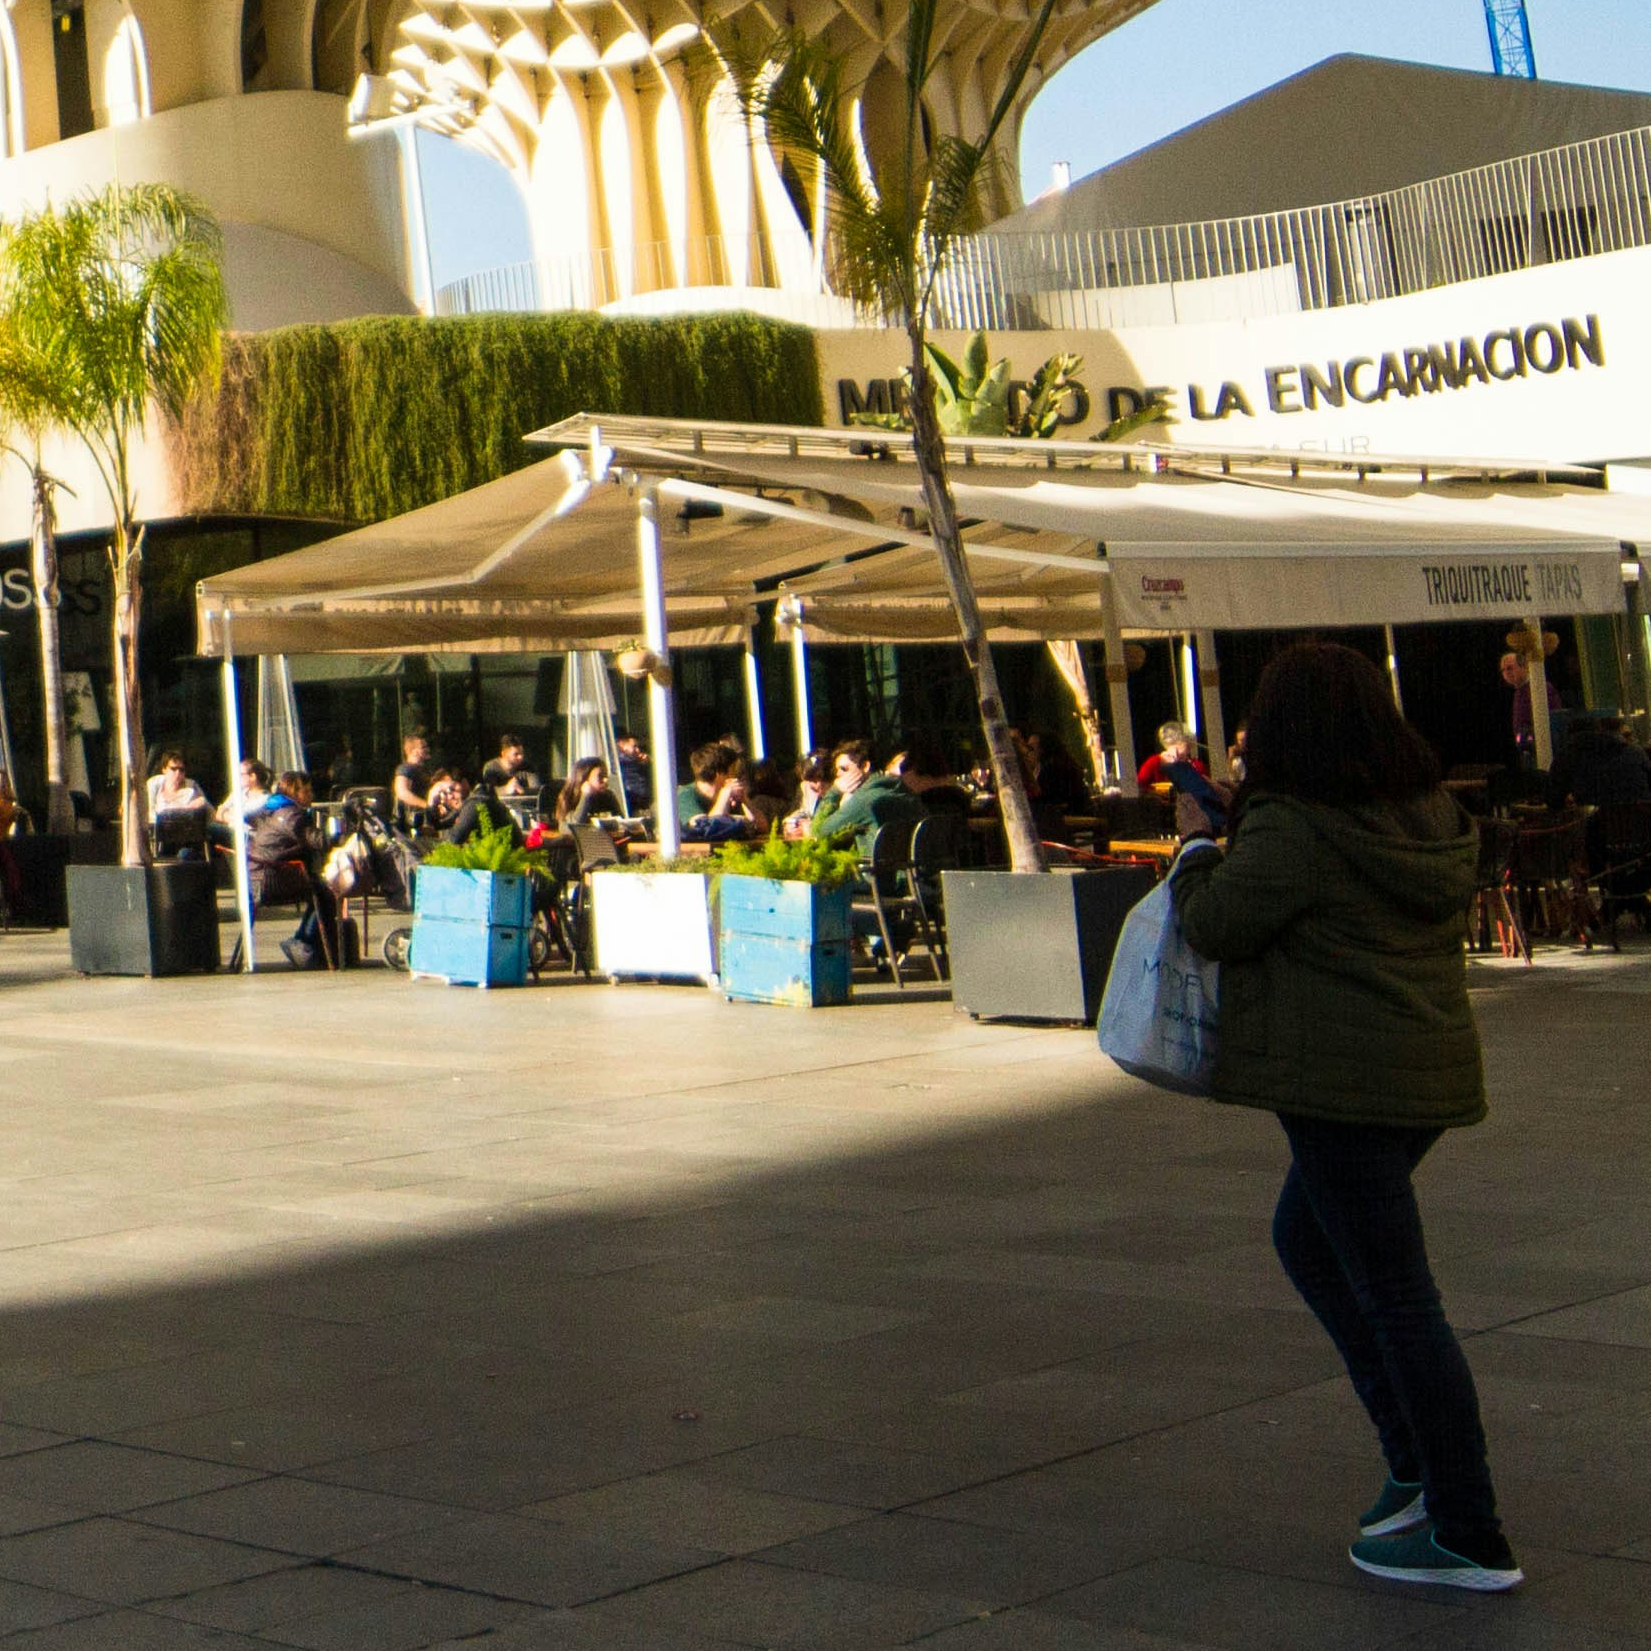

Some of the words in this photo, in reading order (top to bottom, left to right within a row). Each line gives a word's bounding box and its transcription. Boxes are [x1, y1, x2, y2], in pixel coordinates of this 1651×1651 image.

[1108, 385, 1177, 425] DE
[1188, 381, 1255, 421] LA
[1264, 313, 1606, 414] ENCARNACION
[1422, 564, 1532, 605] TRIQUITRAQUE
[1537, 563, 1583, 599] TAPAS
